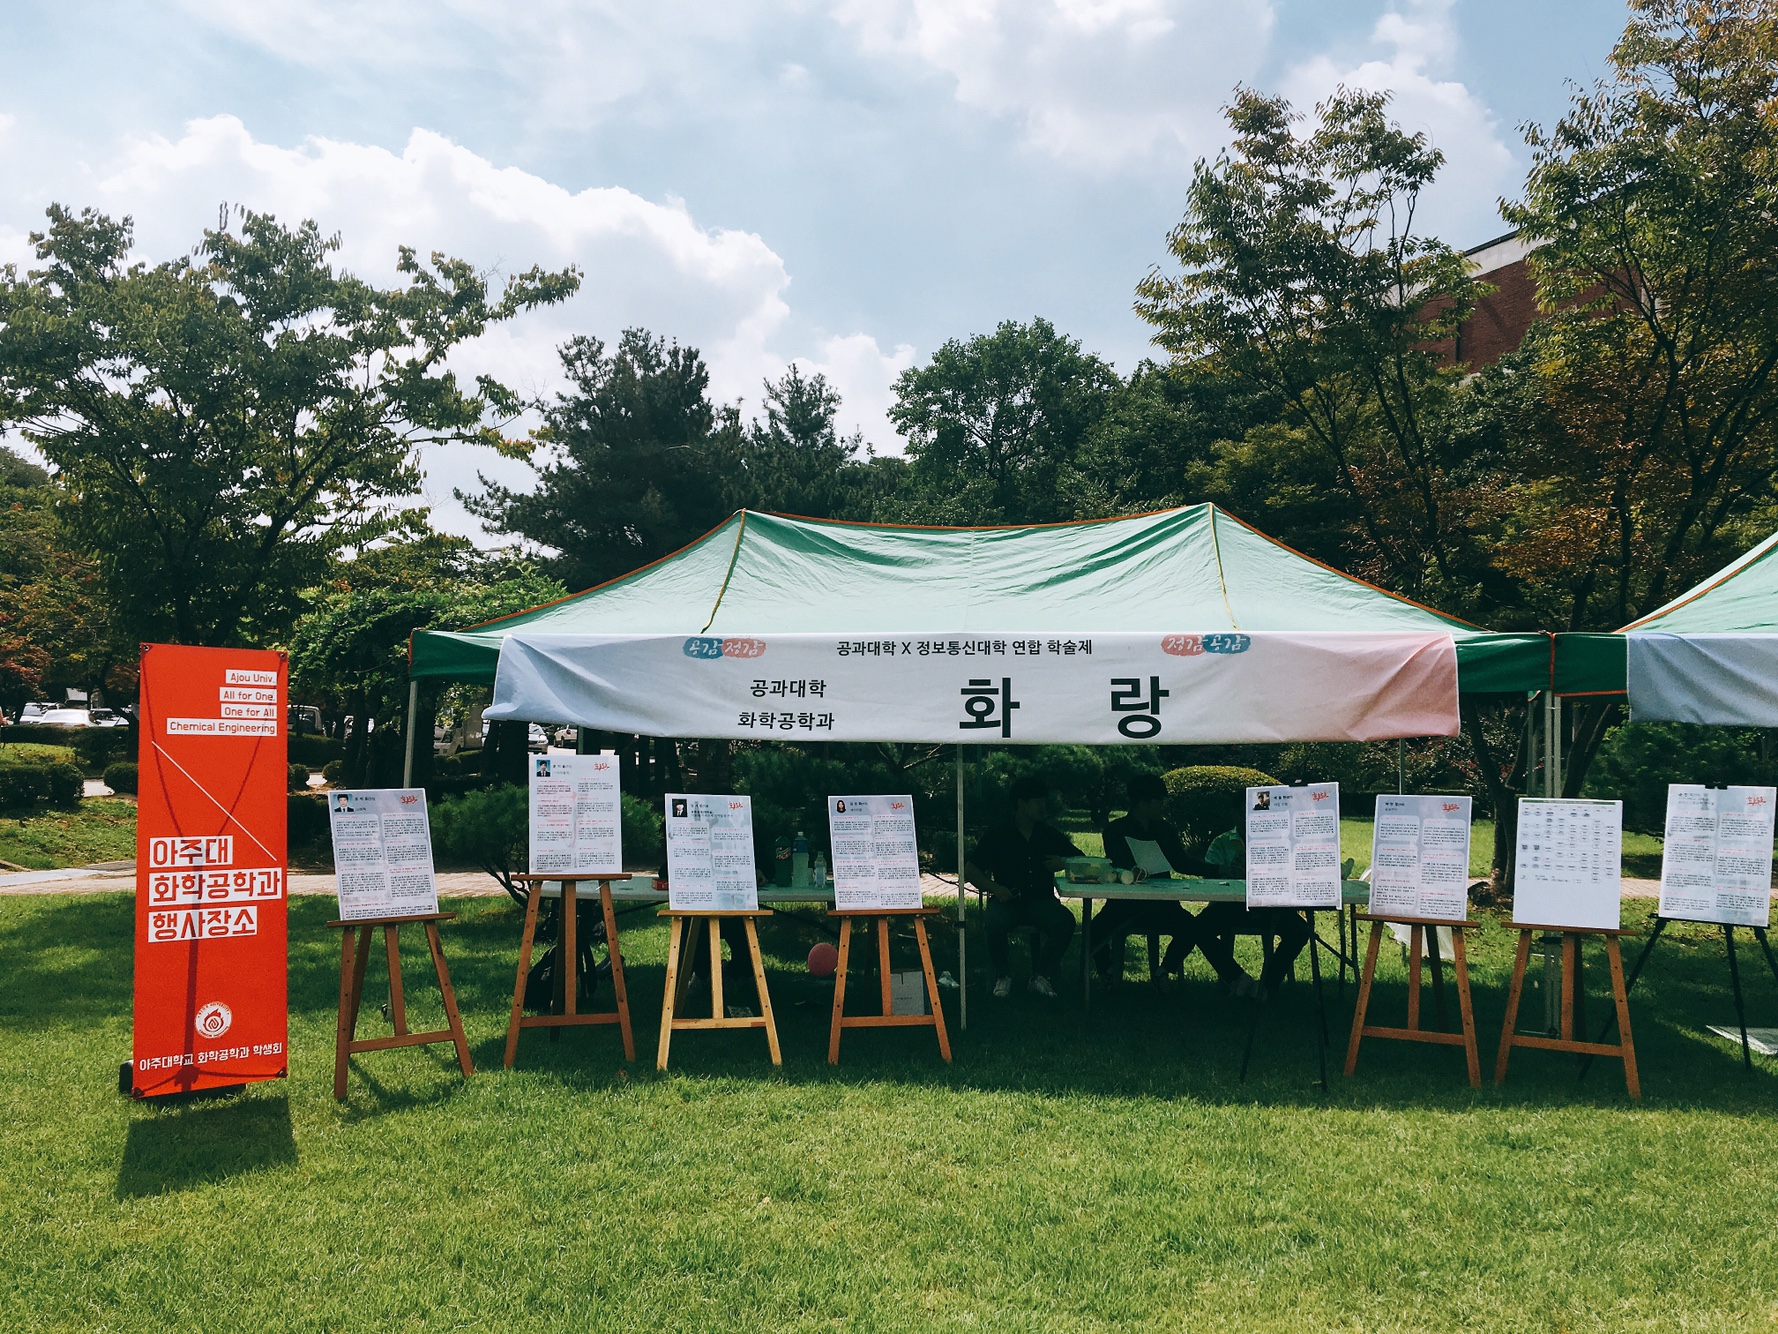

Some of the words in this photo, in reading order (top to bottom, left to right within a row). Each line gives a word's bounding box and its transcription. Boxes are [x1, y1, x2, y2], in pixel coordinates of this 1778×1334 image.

[689, 640, 723, 656] 공감
[724, 640, 764, 656] 정감
[836, 640, 897, 657] 공과대학
[901, 641, 912, 655] X
[916, 640, 1008, 656] 정보통신대학
[1012, 640, 1041, 656] 연합
[1047, 639, 1093, 656] 학술제
[1166, 635, 1208, 652] 정감
[1209, 634, 1247, 652] 공감
[230, 673, 250, 684] Ajou
[252, 673, 276, 684] Univ.
[223, 690, 235, 700] All
[237, 691, 252, 700] for
[255, 691, 276, 702] One.
[750, 679, 827, 699] 공과대학
[224, 707, 243, 717] One
[245, 707, 260, 717] for
[263, 707, 275, 717] All
[958, 676, 1020, 739] 화
[1110, 675, 1170, 739] 랑
[169, 721, 216, 732] Chemical
[218, 722, 276, 735] Engineering
[737, 711, 835, 732] 화학공학과
[153, 838, 229, 866] 아주대
[152, 871, 280, 903] 화학공학과
[152, 909, 256, 940] 행사장소
[139, 1053, 194, 1071] 아주대학교
[197, 1046, 250, 1064] 화학공학과
[252, 1042, 283, 1057] 학생회
